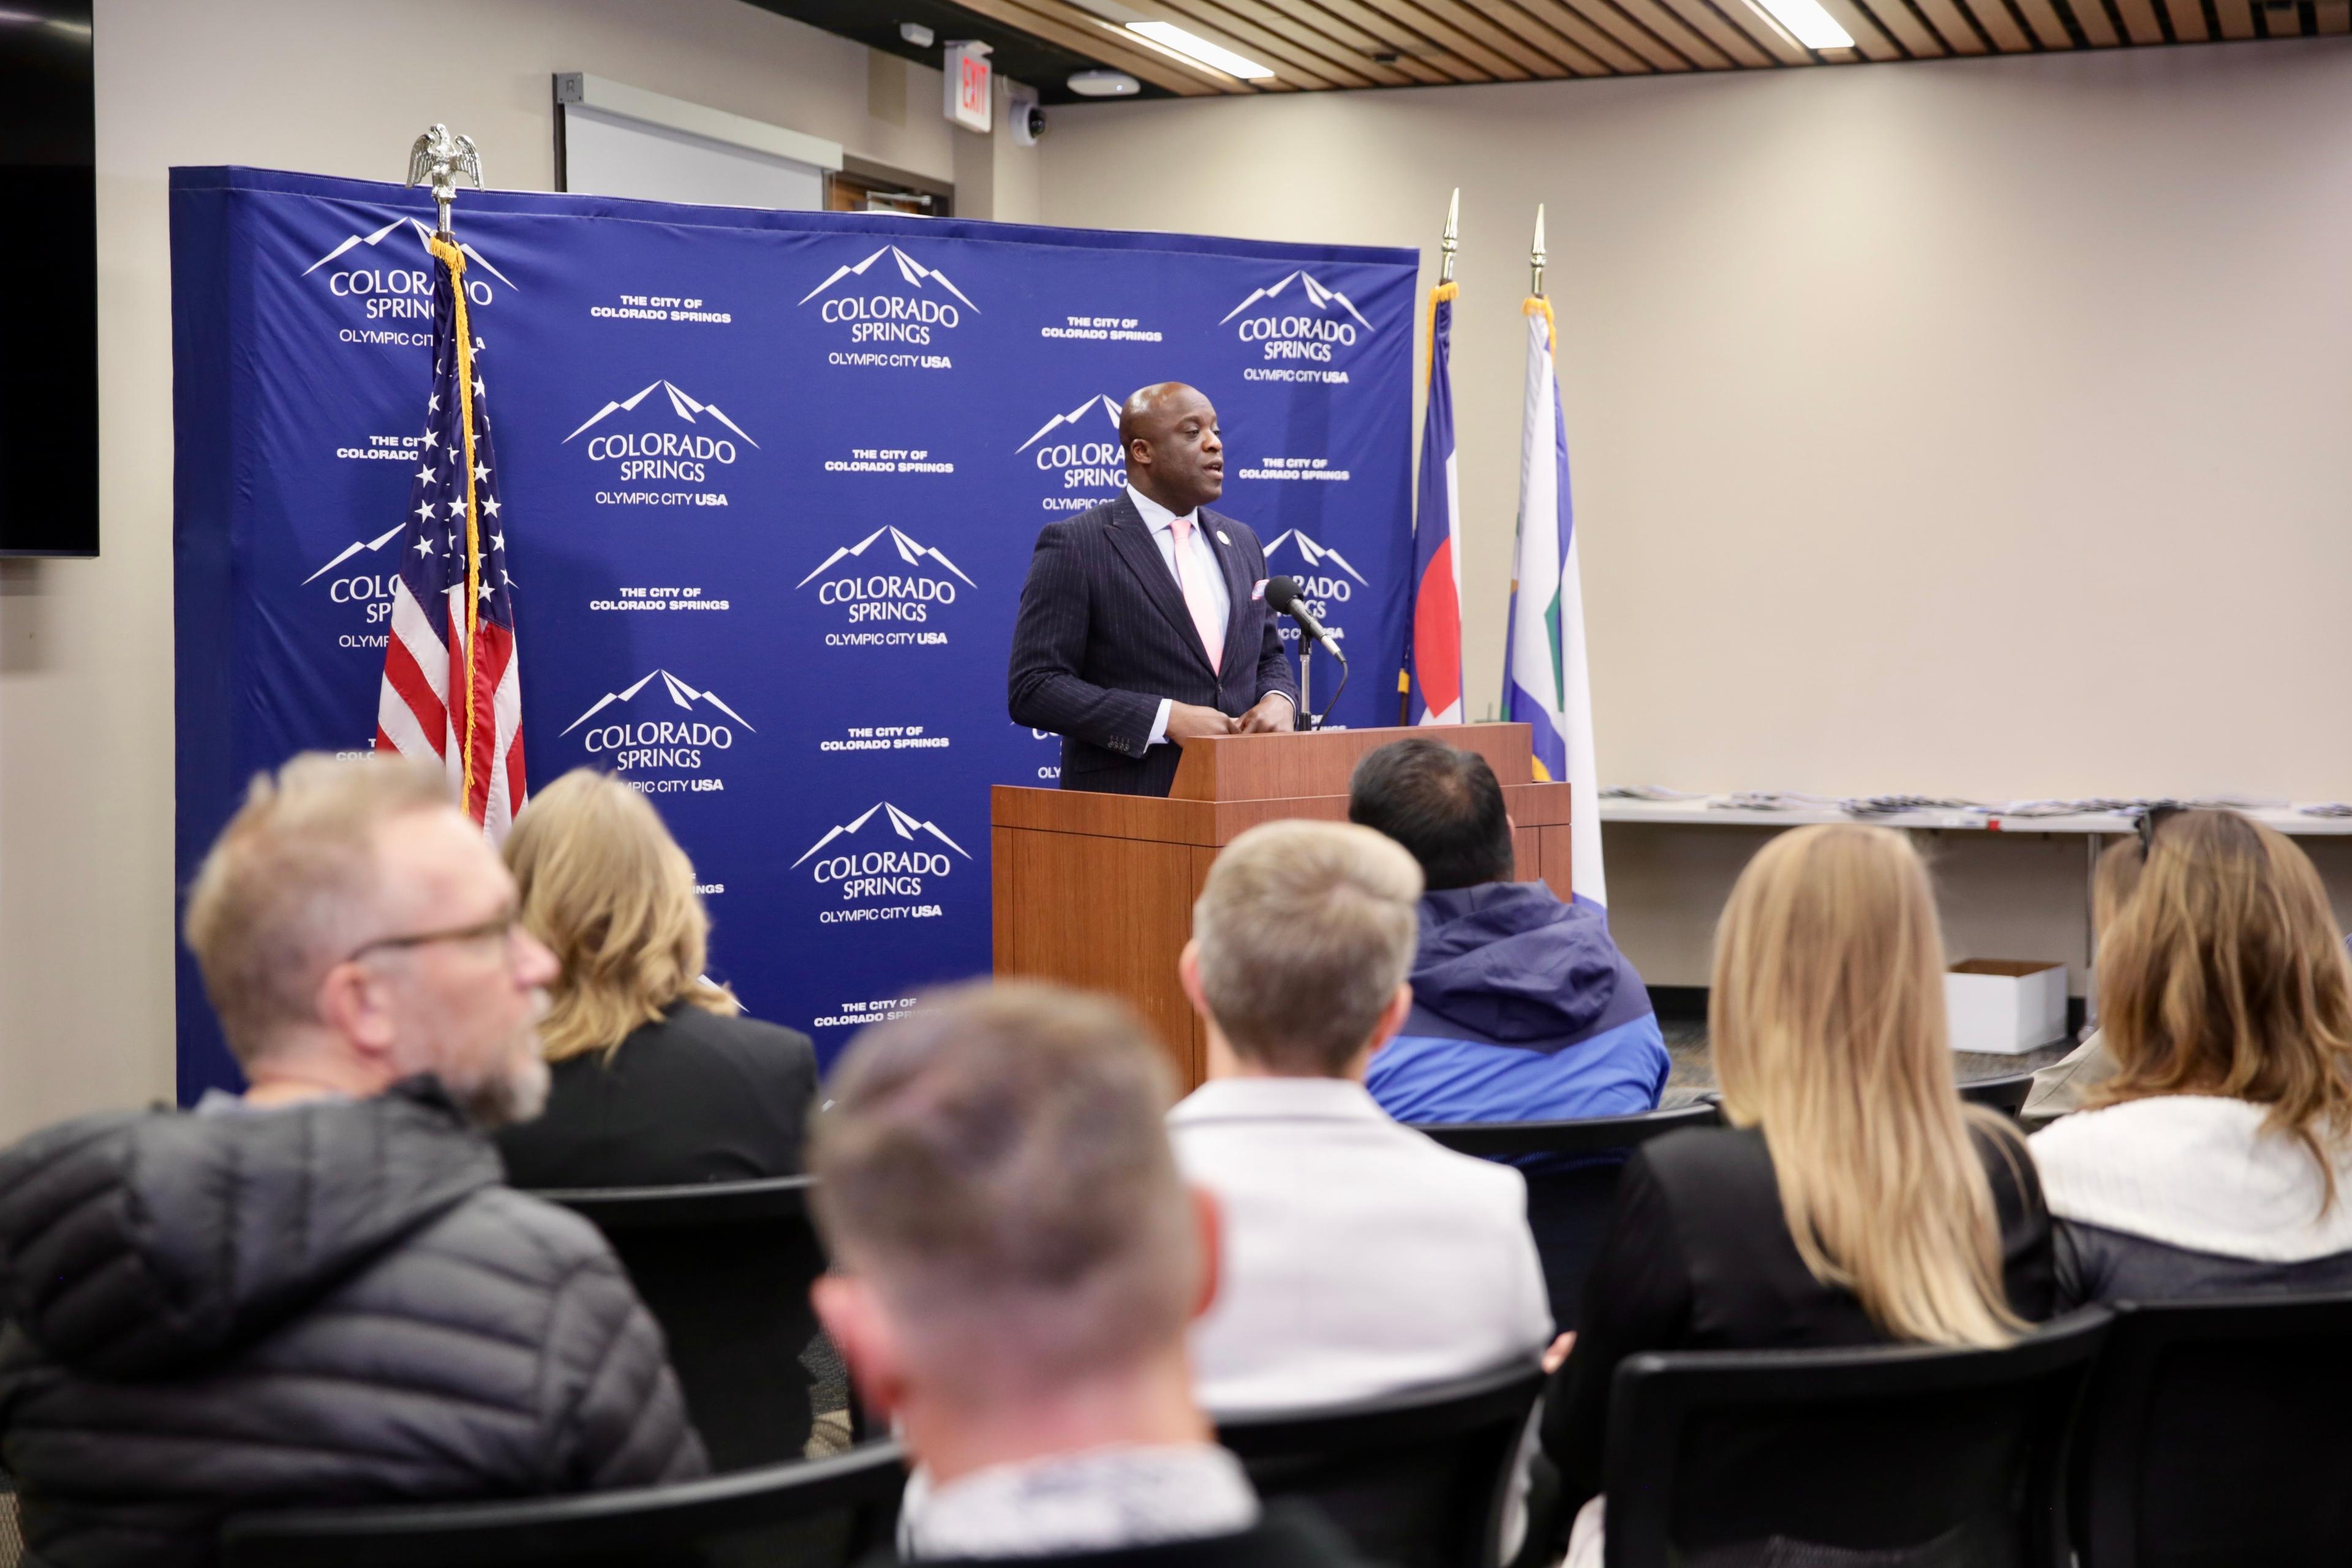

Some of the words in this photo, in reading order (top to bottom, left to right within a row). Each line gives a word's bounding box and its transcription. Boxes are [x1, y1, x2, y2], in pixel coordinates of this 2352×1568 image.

[963, 56, 987, 116] EXIT
[330, 270, 492, 306] COLORO
[367, 298, 434, 319] SPRIN
[620, 295, 647, 306] THE
[650, 297, 680, 307] CITY
[684, 299, 702, 308] OF
[591, 307, 667, 320] COLORADO
[671, 311, 731, 323] SPRINGS
[822, 296, 959, 328] COLORADO
[1068, 317, 1090, 326] THE
[1093, 318, 1119, 328] CITY
[1121, 319, 1137, 328] OF
[340, 330, 409, 345] OLYMPIC
[412, 334, 433, 346] CIT
[853, 323, 930, 345] SPRINGS
[1042, 328, 1107, 339] COLORADO
[1110, 330, 1162, 341] SPRINGS
[1239, 317, 1355, 345] COLORADO
[1264, 341, 1331, 361] SPRINGS
[829, 353, 888, 366] OLYMPIC
[890, 355, 919, 366] CITY
[921, 356, 951, 368] USA
[1244, 369, 1295, 382] OLYMPIC
[1295, 371, 1321, 382] CITY
[1322, 372, 1349, 383] USA
[370, 436, 398, 446] THE
[589, 433, 736, 464] COLORADO
[337, 448, 418, 460] COLORADO
[853, 450, 877, 459] THE
[880, 450, 908, 459] CITY
[911, 451, 927, 460] OF
[1037, 443, 1125, 470] COLORA
[825, 461, 895, 472] COLORADO
[898, 462, 954, 473] SPRINGS
[1263, 458, 1284, 467] THE
[1286, 459, 1311, 468] CITY
[1313, 459, 1327, 468] OF
[621, 460, 704, 482] SPRINGS
[1065, 469, 1128, 488] SPRING
[1239, 469, 1300, 479] COLORADO
[1302, 470, 1349, 480] SPRINGS
[596, 492, 658, 505] OLYMPIC
[662, 493, 693, 505] CITY
[696, 494, 728, 505] USA
[620, 588, 646, 597] THE
[650, 588, 679, 597] CITY
[683, 588, 701, 597] OF
[820, 576, 956, 605] COLORADO
[590, 601, 666, 610] COLORADO
[669, 601, 729, 610] SPRINGS
[849, 602, 926, 623] SPRINGS
[826, 633, 884, 646] OLYMPIC
[886, 633, 915, 645] CITY
[918, 633, 948, 644] USA
[586, 722, 731, 752] COLORADO
[848, 728, 872, 737] THE
[876, 727, 903, 736] CITY
[906, 726, 923, 736] OF
[821, 740, 891, 750] COLORADO
[894, 738, 949, 748] SPRINGS
[617, 748, 701, 771] SPRINGS
[658, 780, 688, 792] CITY
[692, 779, 723, 791] USA
[815, 851, 950, 883] COLORADO
[692, 884, 724, 894] INGS
[843, 877, 921, 899] SPRINGS
[820, 909, 878, 922] OLYMPIC
[881, 907, 910, 919] CITY
[912, 905, 942, 918] USA
[842, 1003, 866, 1012] THE
[870, 1000, 897, 1010] CITY
[899, 998, 917, 1008] OF
[814, 1014, 884, 1027] COLORADO
